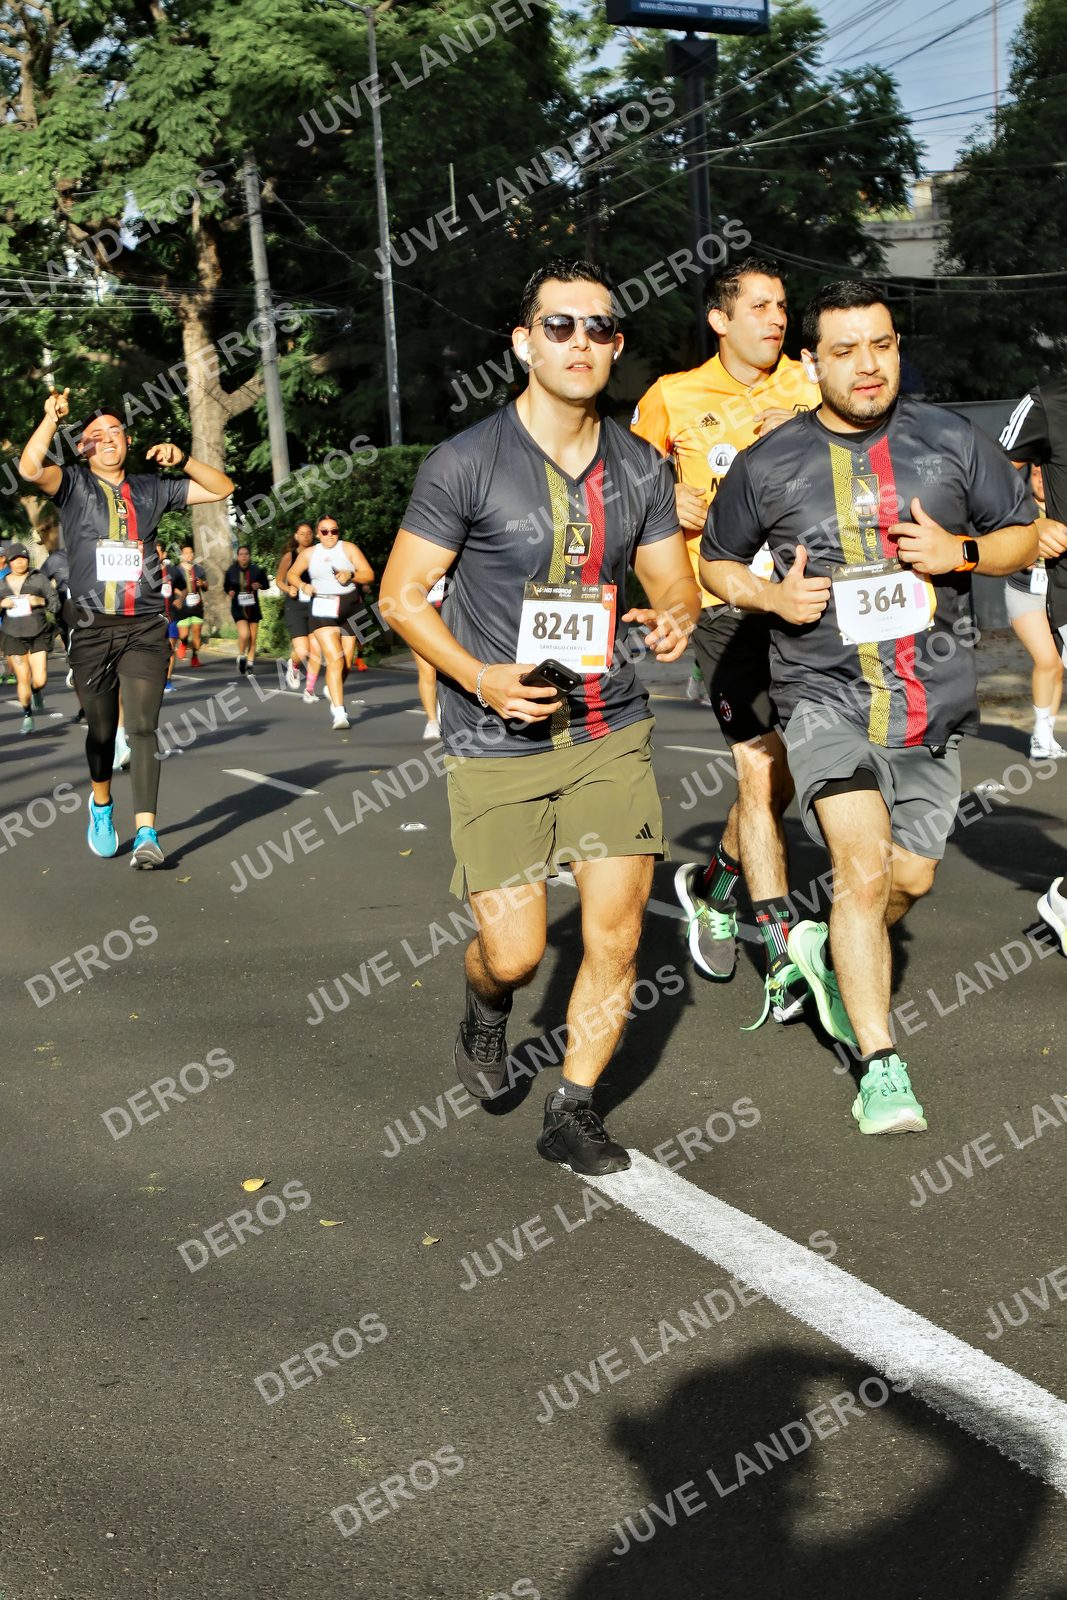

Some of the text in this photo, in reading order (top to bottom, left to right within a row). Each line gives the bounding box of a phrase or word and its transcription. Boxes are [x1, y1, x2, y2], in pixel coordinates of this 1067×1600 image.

[100, 554, 140, 567] 10288
[856, 583, 907, 615] 364
[533, 611, 594, 641] 8241
